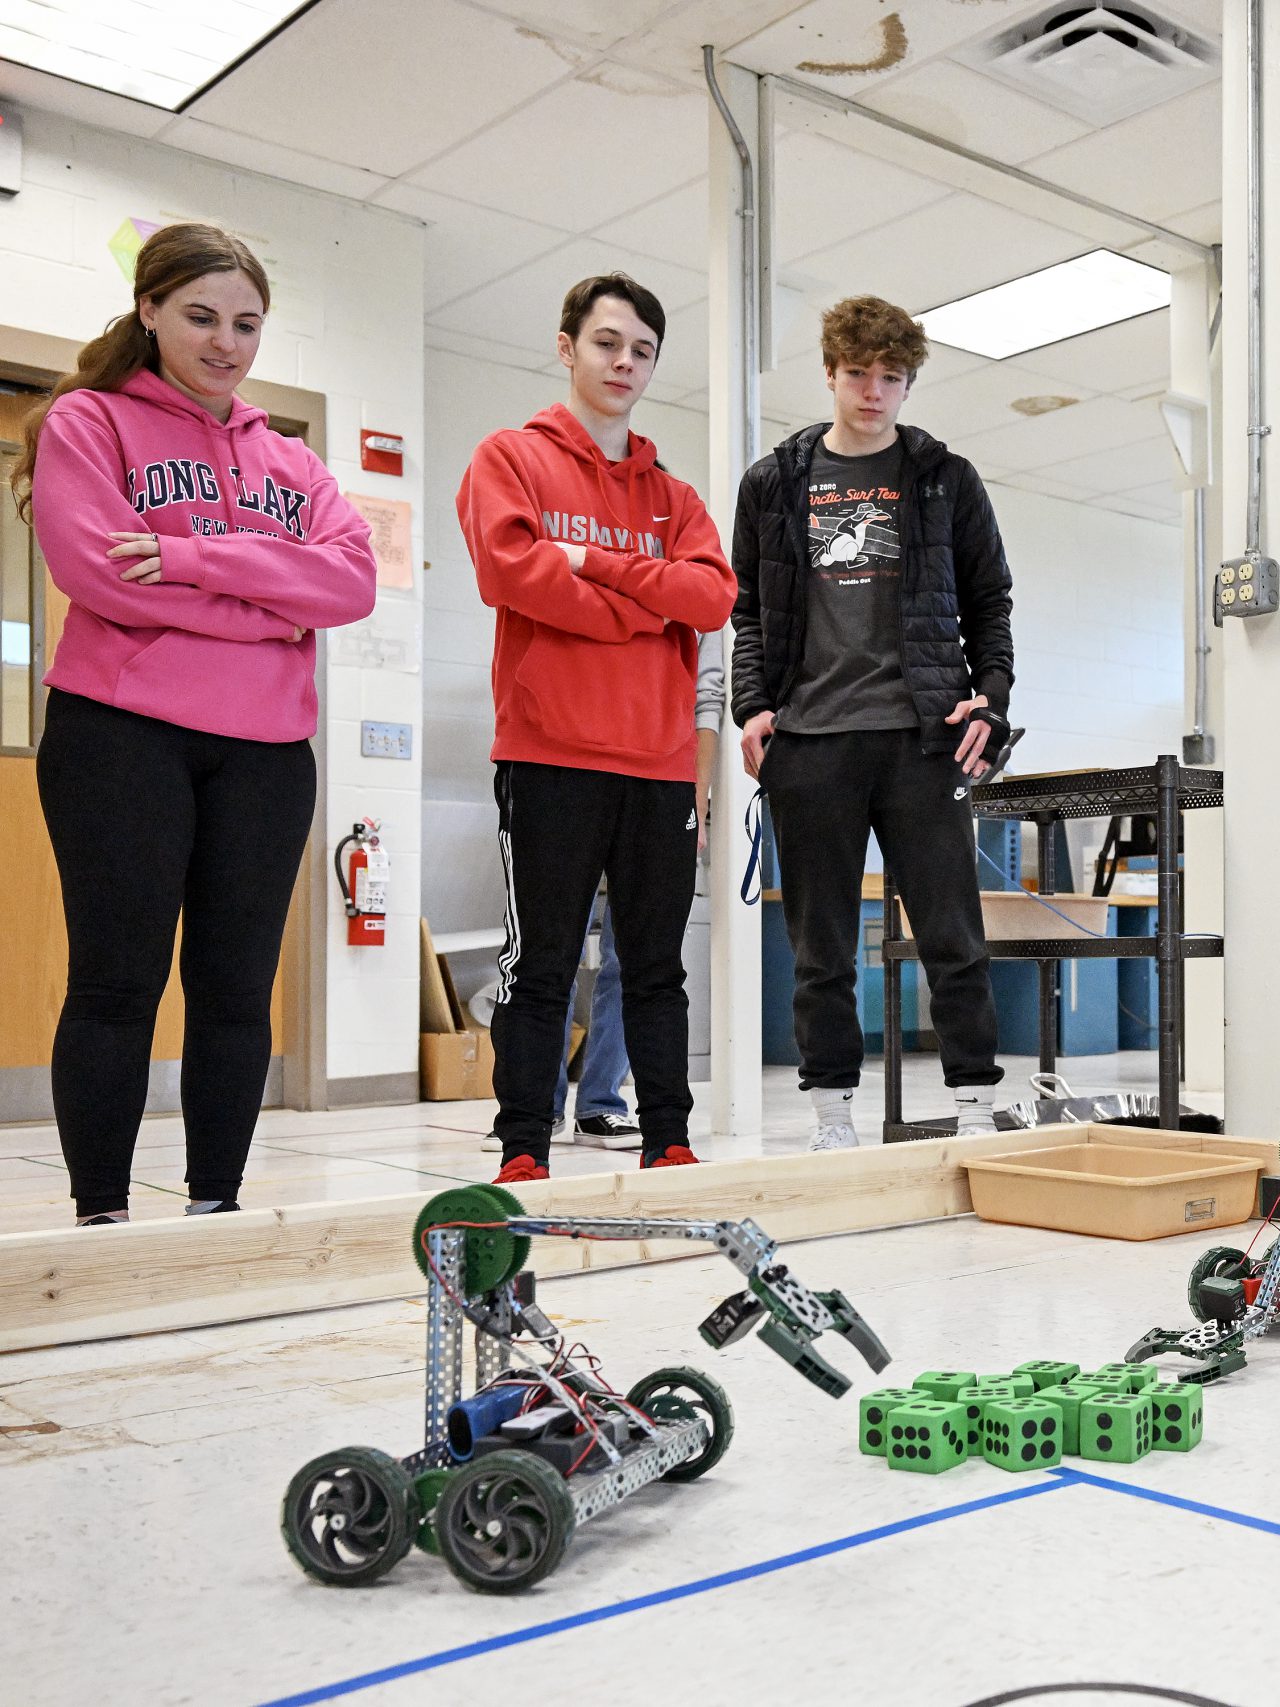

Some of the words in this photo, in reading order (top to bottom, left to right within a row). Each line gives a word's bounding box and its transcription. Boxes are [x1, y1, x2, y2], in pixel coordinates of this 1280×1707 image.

[128, 459, 221, 515] LONG
[229, 467, 311, 541] LAK
[844, 488, 876, 501] Surf
[190, 514, 228, 536] NEW
